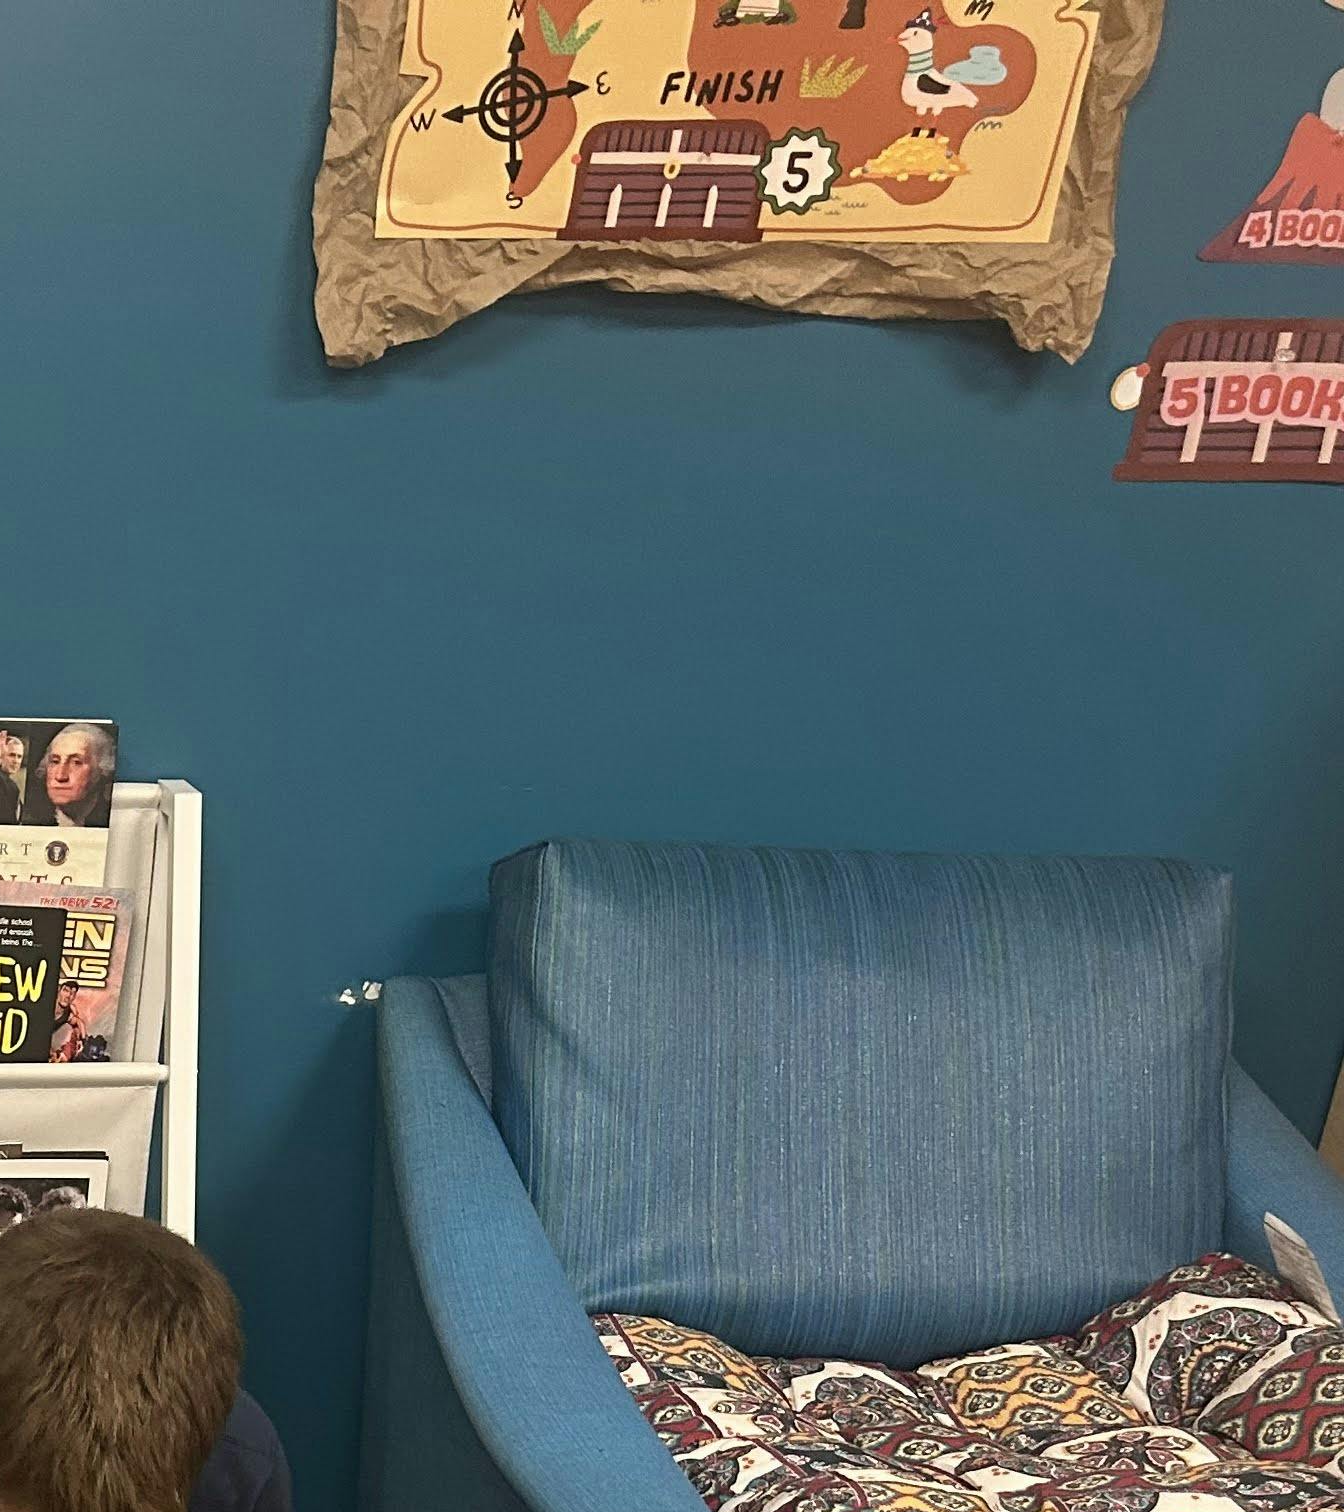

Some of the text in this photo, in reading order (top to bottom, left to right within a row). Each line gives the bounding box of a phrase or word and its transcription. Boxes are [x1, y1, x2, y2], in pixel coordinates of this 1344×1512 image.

[660, 69, 784, 105] FINISH
[410, 109, 437, 133] W
[783, 151, 813, 193] 5
[505, 192, 523, 210] S
[1245, 213, 1344, 243] 4 BOO
[1167, 374, 1344, 421] 5 BOOK
[59, 898, 88, 907] NEW
